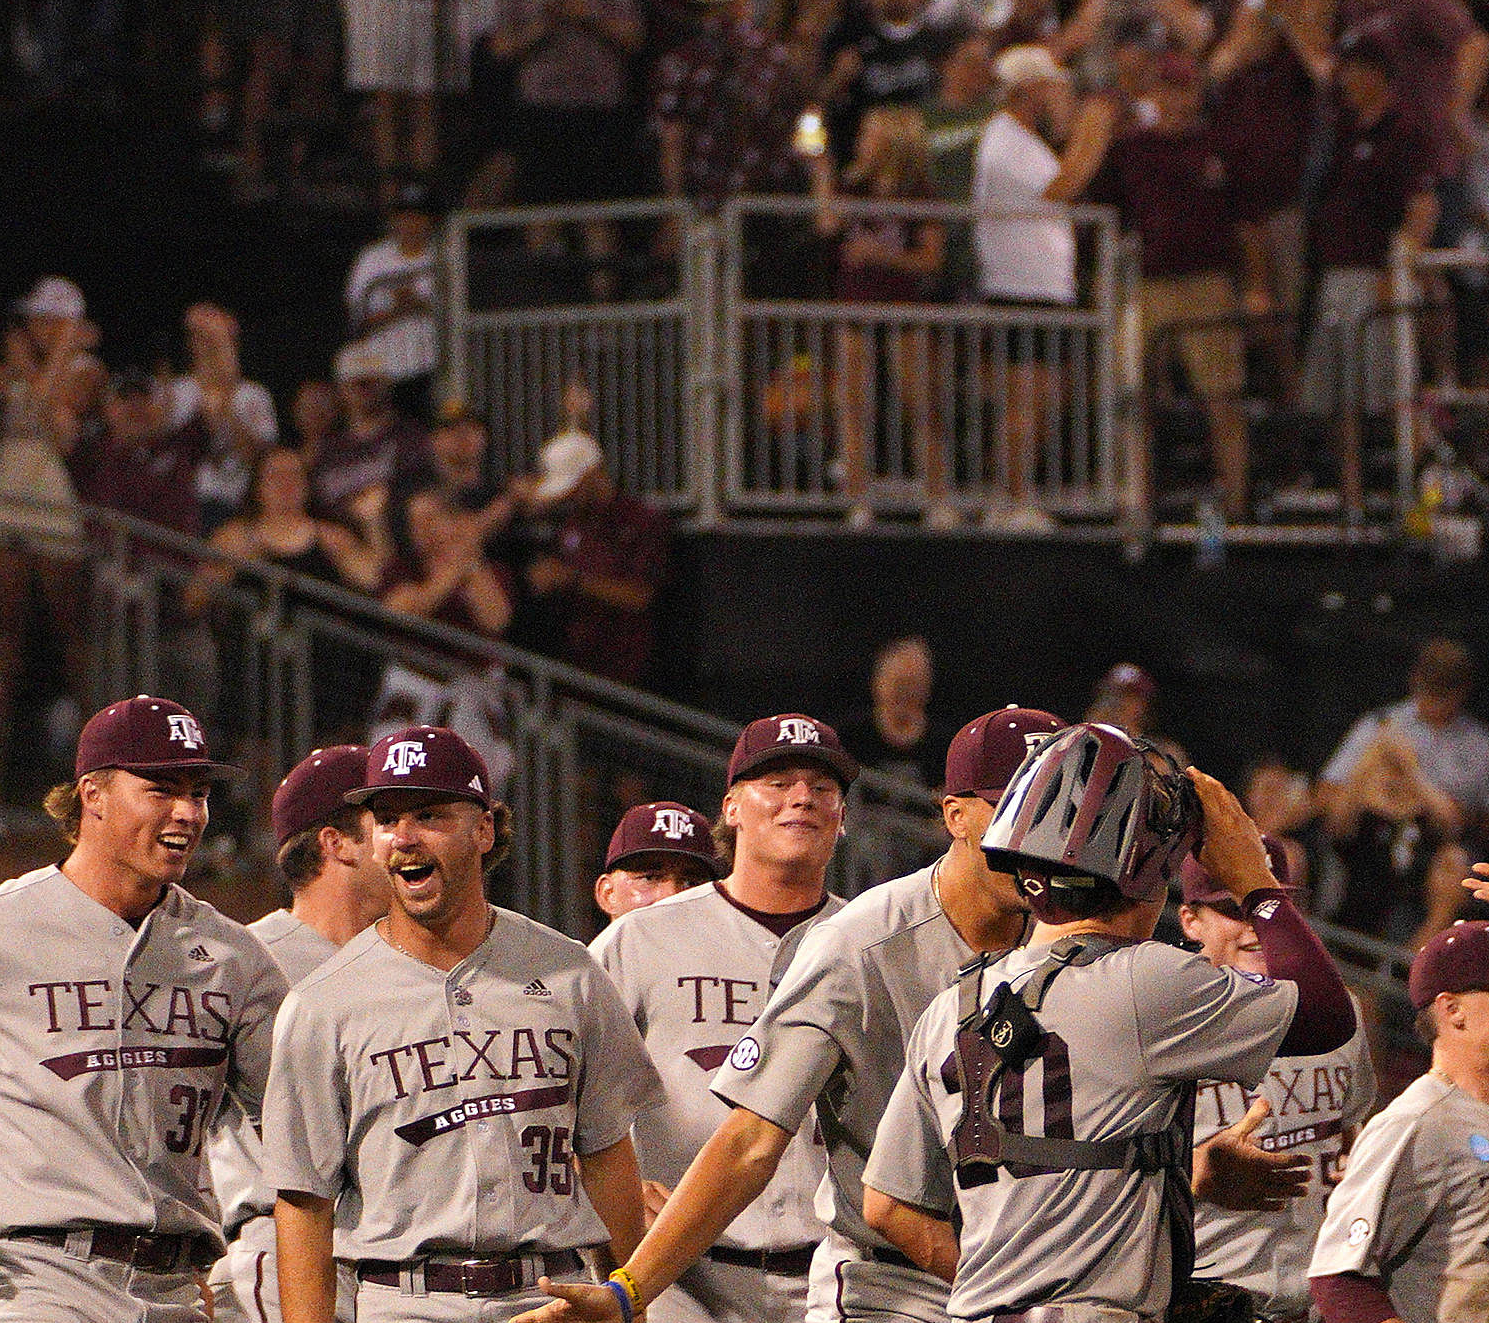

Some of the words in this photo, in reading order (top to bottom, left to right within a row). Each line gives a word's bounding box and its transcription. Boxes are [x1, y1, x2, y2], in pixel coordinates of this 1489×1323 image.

[29, 979, 231, 1044] TEXAS
[86, 1049, 169, 1069] AGGIES
[369, 1028, 573, 1100] TEXAS
[434, 1096, 517, 1130] AGGIES
[520, 1125, 573, 1196] 35
[1262, 1126, 1317, 1152] GGIES
